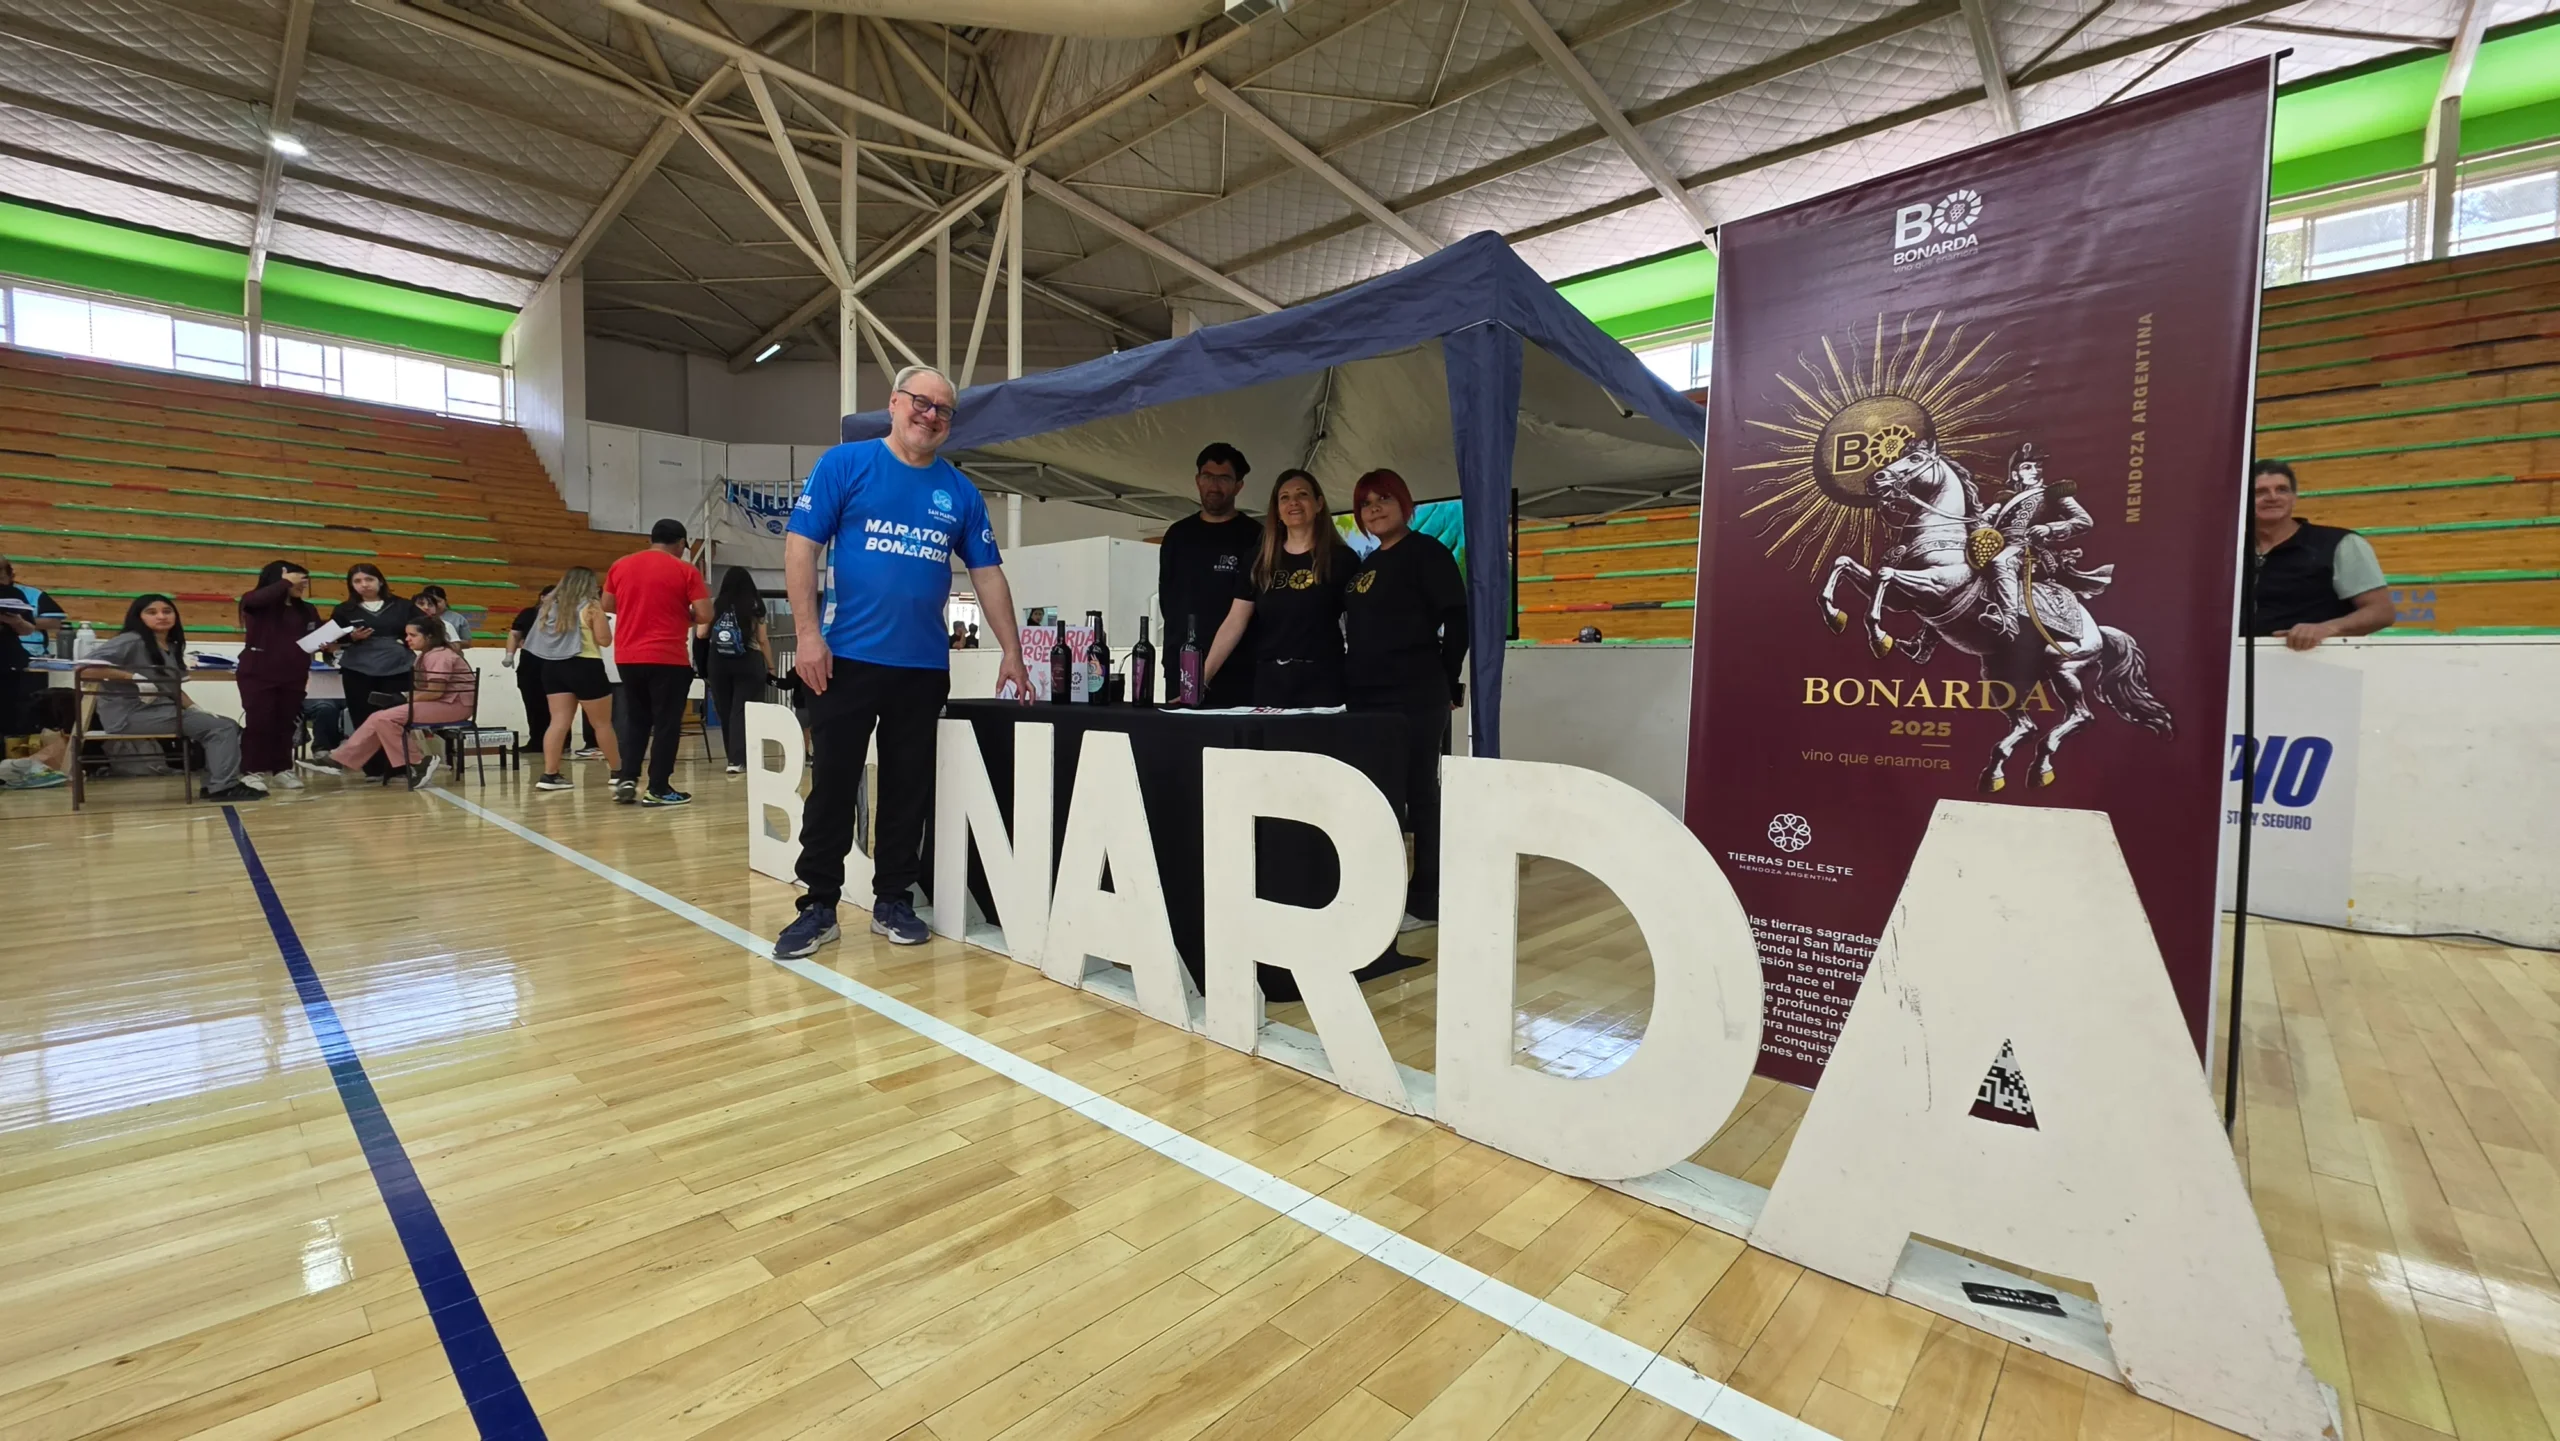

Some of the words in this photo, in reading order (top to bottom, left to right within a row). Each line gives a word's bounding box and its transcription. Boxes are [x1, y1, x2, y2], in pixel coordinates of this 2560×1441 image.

[1893, 233, 1978, 266] BONARDA
[1894, 263, 1912, 273] vino
[1916, 259, 1933, 270] que
[1936, 248, 1978, 264] enamora
[2132, 312, 2153, 423] ARGENTINA
[2126, 430, 2145, 523] MENDOZA
[928, 508, 939, 517] SAN
[865, 537, 948, 564] BONARDA
[1021, 629, 1095, 646] BONRDA
[1803, 677, 2055, 711] BONARDA
[1890, 720, 1951, 737] 2025
[1801, 749, 1833, 761] vino
[1838, 752, 1868, 765] que
[1874, 754, 1950, 770] enamora
[2261, 813, 2312, 831] SEGURO
[1727, 851, 1783, 867] TIERRAS
[1787, 860, 1814, 871] DEL
[1817, 864, 1853, 876] ESTE
[1739, 865, 1782, 875] MENDOZA
[1785, 871, 1838, 882] ARGENTINA
[1749, 914, 1768, 926] las
[1771, 918, 1813, 934] tierras
[1816, 928, 1880, 946] sagradas
[1752, 927, 1799, 944] General
[1803, 936, 1829, 950] San
[1760, 956, 1794, 969] asión
[1797, 963, 1813, 973] se
[1817, 967, 1863, 982] entrela
[1796, 948, 1808, 959] la
[1812, 951, 1864, 970] historia
[1763, 981, 1791, 994] arda
[1795, 988, 1820, 1000] que
[1787, 974, 1819, 987] nace
[1822, 980, 1835, 990] el
[1772, 1006, 1822, 1026] frutales
[1777, 997, 1838, 1017] profundo
[1775, 1033, 1833, 1055] conquist
[1787, 1024, 1837, 1043] nuestra
[1796, 1052, 1813, 1063] en
[744, 701, 2342, 1441] BNARDA
